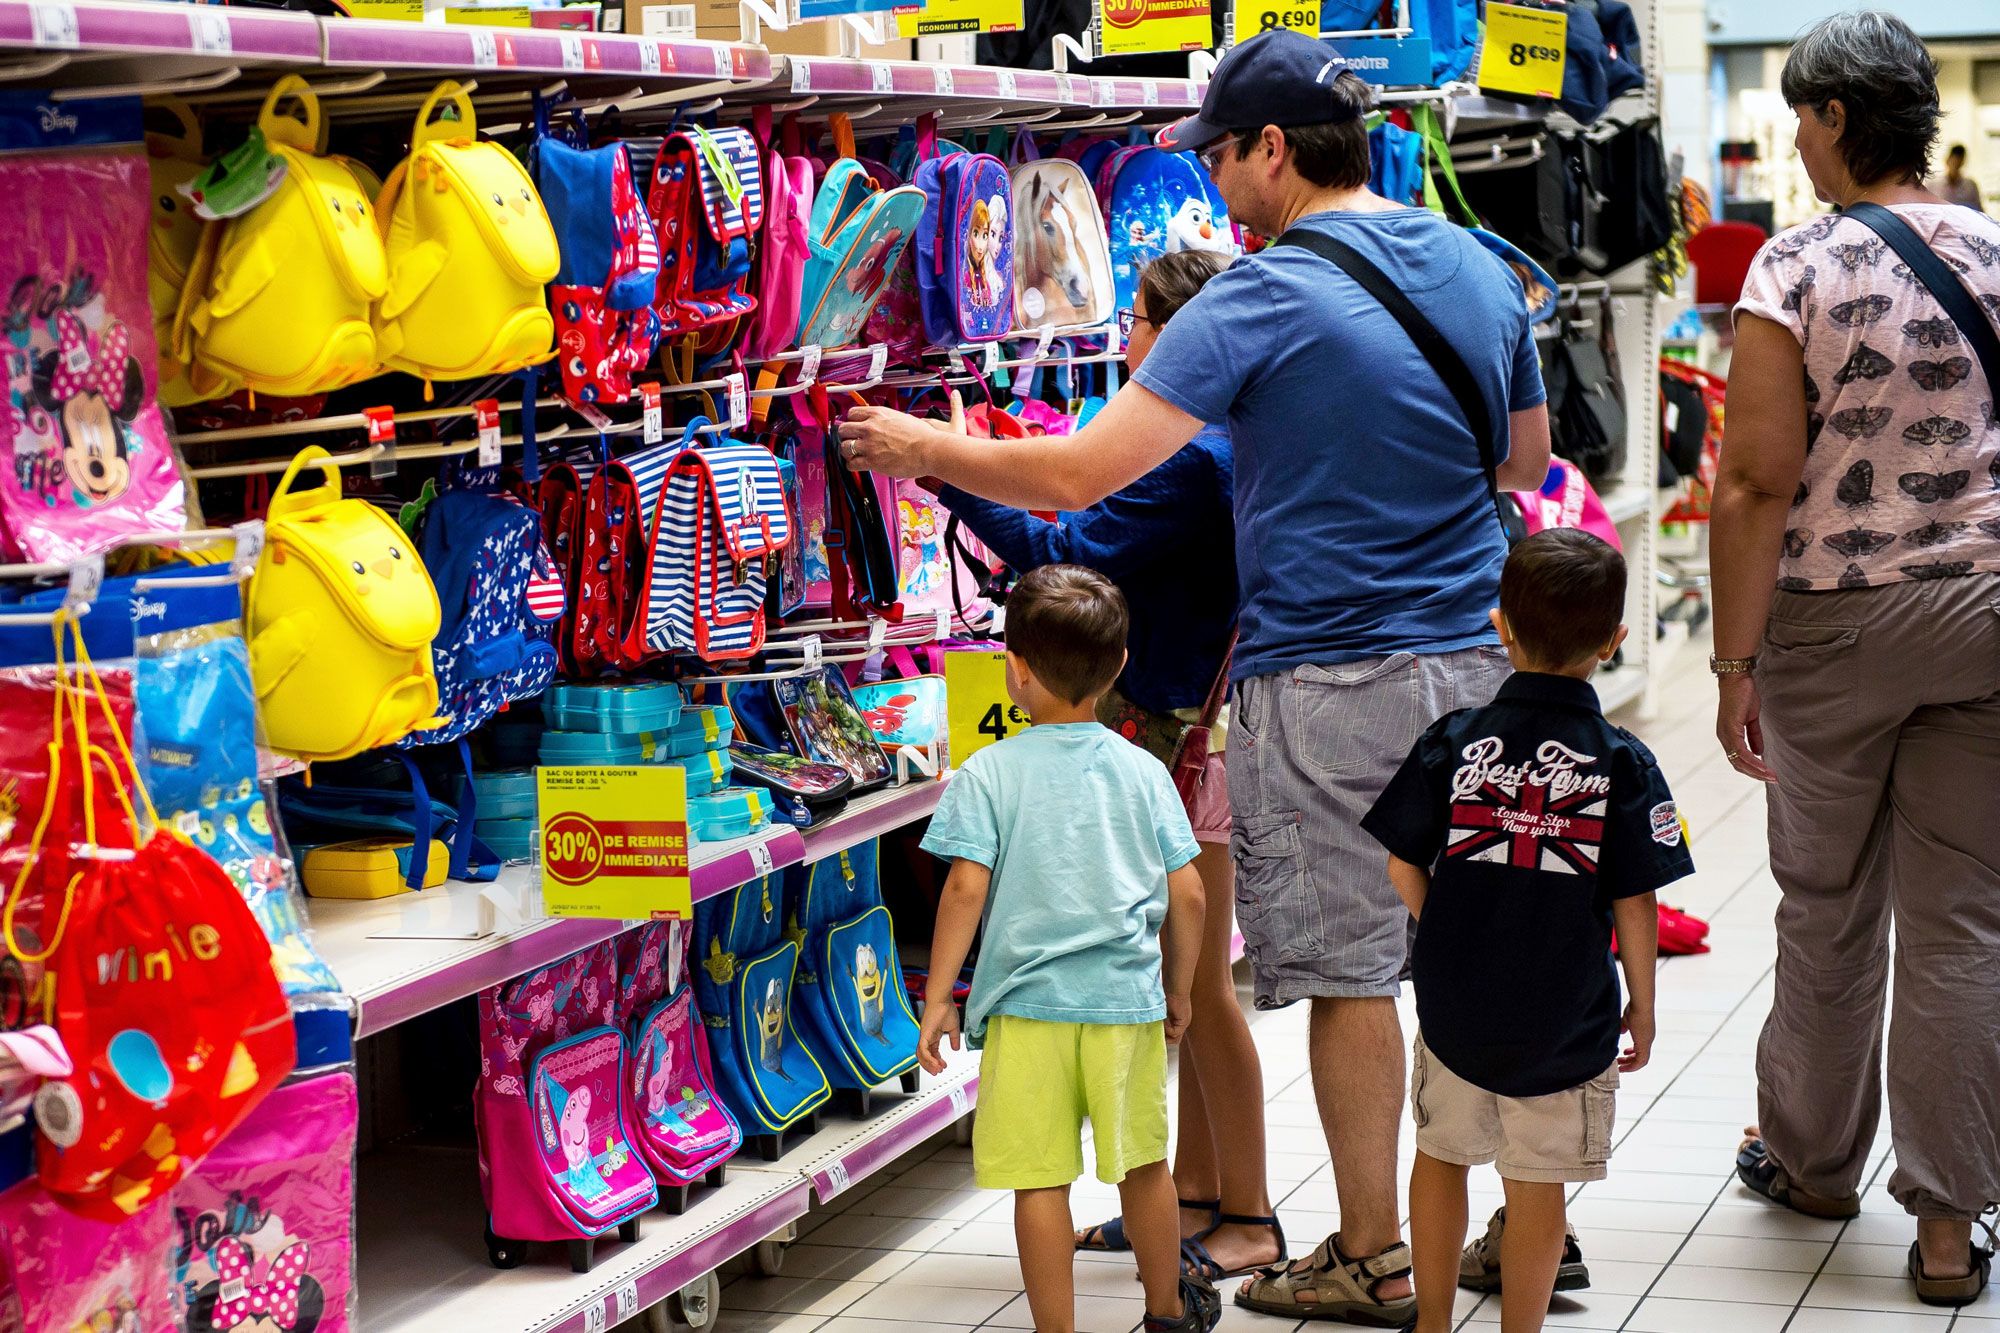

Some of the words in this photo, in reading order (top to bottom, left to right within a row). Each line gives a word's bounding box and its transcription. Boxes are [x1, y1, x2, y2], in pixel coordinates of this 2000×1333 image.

[893, 6, 919, 15] Auchan
[1148, 0, 1209, 11] IMMEDIATE
[919, 22, 959, 33] ECONOMIE
[37, 105, 79, 135] Disney
[808, 462, 825, 480] Pri
[128, 597, 167, 621] Disney
[1450, 736, 1532, 804] Best
[1492, 806, 1539, 823] London
[1502, 819, 1528, 833] New
[548, 831, 597, 862] 30%
[604, 836, 624, 848] DE
[627, 836, 684, 848] REMISE
[604, 854, 688, 867] IMMEDIATE
